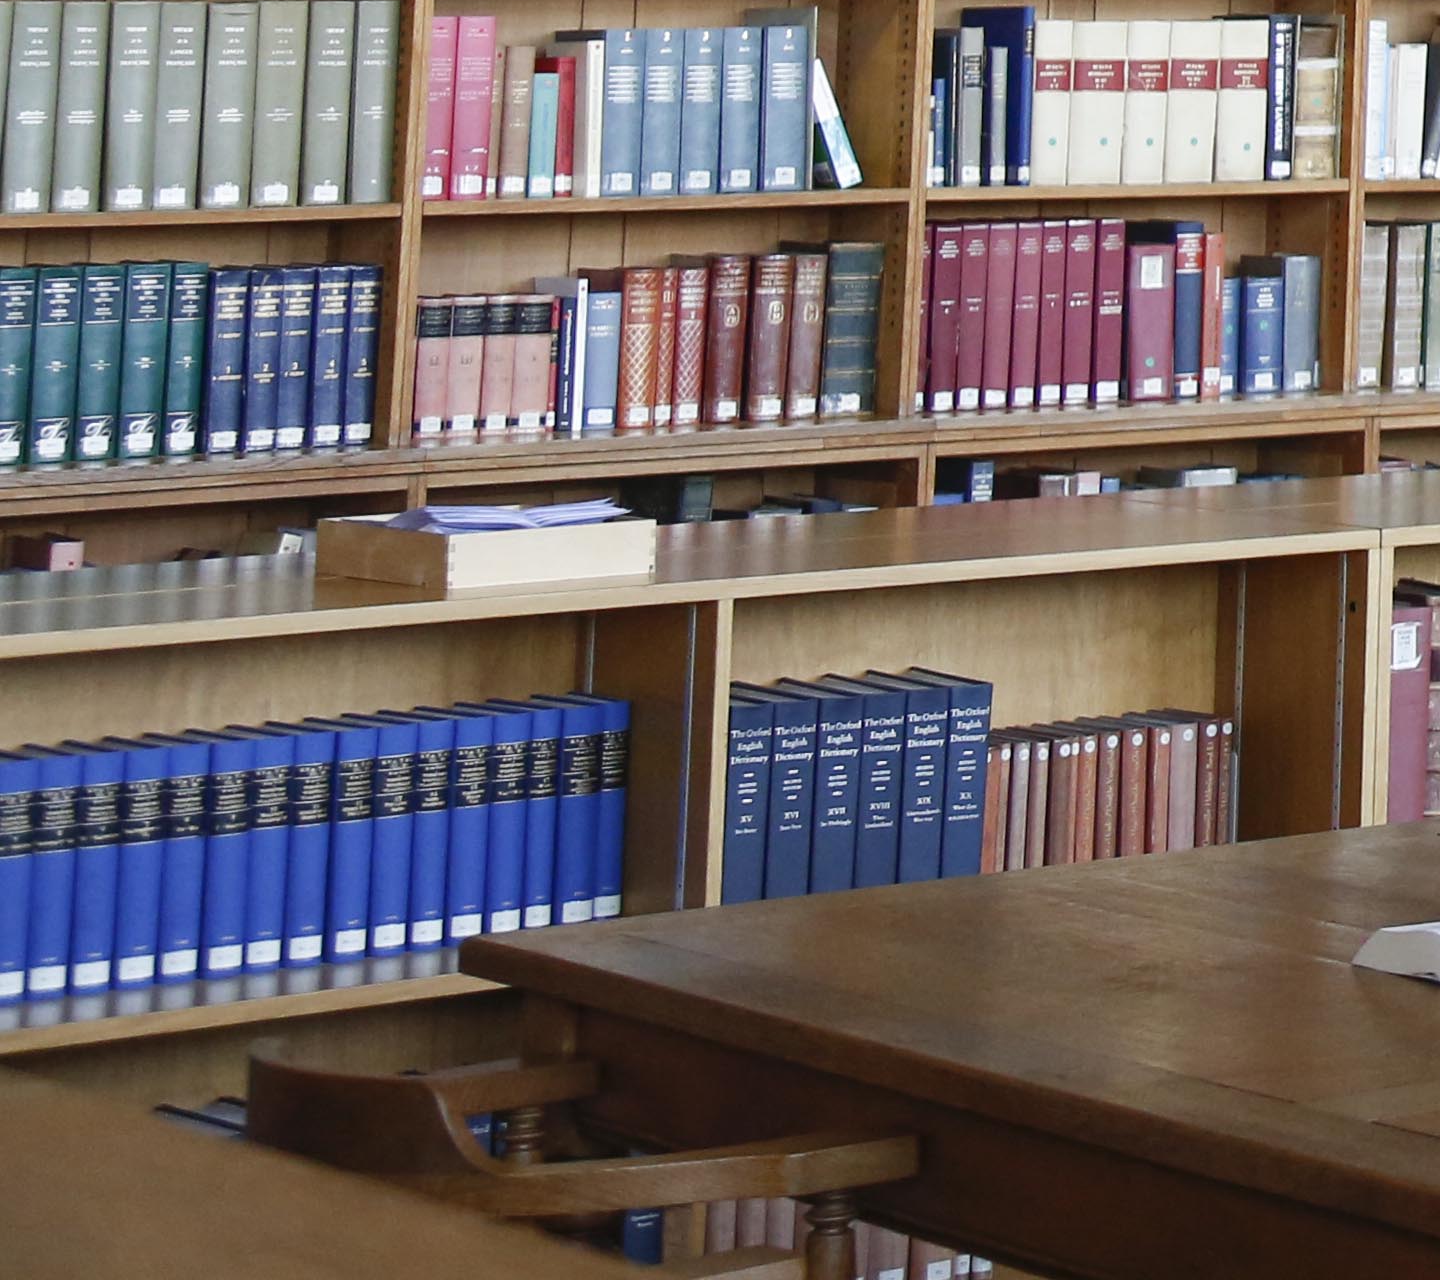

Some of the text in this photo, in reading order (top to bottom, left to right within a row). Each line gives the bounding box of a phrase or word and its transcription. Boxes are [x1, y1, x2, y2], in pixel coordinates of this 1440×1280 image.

[624, 31, 632, 41] 1
[663, 31, 671, 41] 2
[702, 31, 710, 41] 3
[741, 30, 749, 40] 4
[785, 29, 793, 39] 5
[907, 710, 948, 722] The Oxford
[950, 706, 989, 717] The Oxford
[821, 720, 862, 732] The Oxford
[864, 716, 904, 727] The Oxford
[957, 720, 982, 730] English
[731, 727, 772, 738] The Oxford
[775, 724, 816, 735] The Oxford
[870, 728, 896, 740] English
[914, 724, 940, 735] English
[782, 737, 808, 748] English
[827, 733, 853, 745] English
[907, 738, 945, 748] Dictionary
[950, 733, 987, 744] Dictionary
[737, 741, 763, 752] English
[863, 743, 902, 753] Dictionary
[775, 752, 814, 762] Dictionary
[820, 747, 859, 758] Dictionary
[731, 755, 768, 765] Dictionary
[917, 797, 931, 805] XIX
[959, 792, 972, 800] XX
[870, 802, 890, 810] XVIII
[784, 811, 799, 820] XVI
[828, 807, 846, 816] XVII
[740, 815, 752, 824] XV
